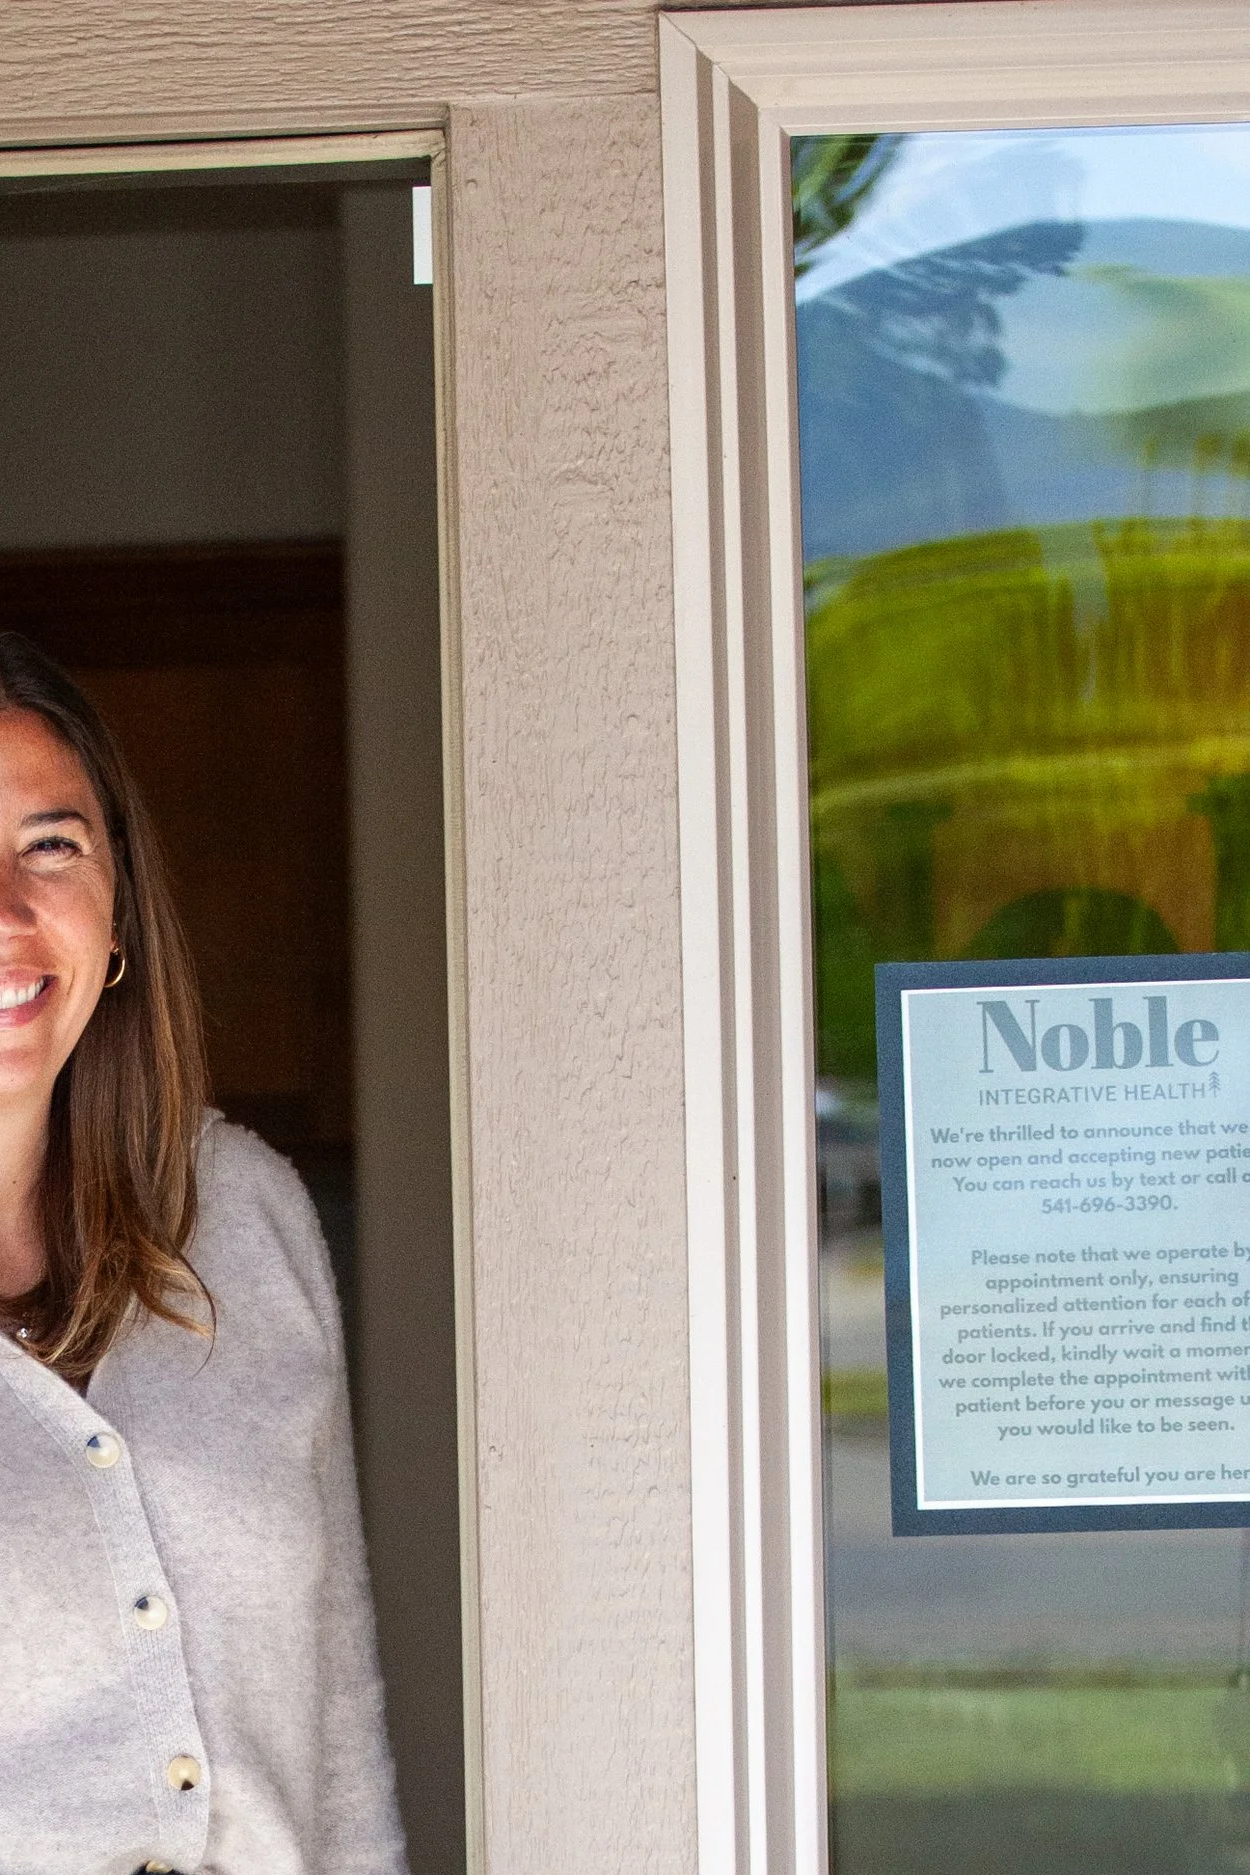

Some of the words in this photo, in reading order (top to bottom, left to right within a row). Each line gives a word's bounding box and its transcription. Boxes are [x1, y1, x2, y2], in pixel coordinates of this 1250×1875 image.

[976, 995, 1220, 1073] Noble
[979, 1085, 1117, 1106] INTEGRATIVE
[1124, 1082, 1206, 1101] HEALTH
[930, 1126, 984, 1144] We're
[989, 1124, 1056, 1142] thrilled
[1060, 1125, 1079, 1140] to
[1084, 1123, 1174, 1140] announce
[1178, 1120, 1216, 1135] that
[1220, 1123, 1248, 1134] we
[931, 1155, 972, 1169] now
[976, 1153, 1022, 1171] open
[1027, 1148, 1063, 1165] and
[1068, 1146, 1156, 1165] accepting
[1162, 1148, 1200, 1161] new
[953, 1176, 987, 1192] You
[993, 1179, 1025, 1191] can
[1030, 1173, 1081, 1190] reach
[1086, 1176, 1106, 1188] us
[1111, 1170, 1134, 1191] by
[1139, 1171, 1176, 1187] text
[1180, 1174, 1200, 1185] or
[1206, 1167, 1237, 1184] call
[1041, 1194, 1179, 1214] 541-696-3390.
[971, 1250, 1030, 1266] Please
[1035, 1249, 1075, 1264] note
[1081, 1246, 1119, 1262] that
[1123, 1249, 1151, 1261] we
[1155, 1244, 1229, 1263] operate
[986, 1273, 1104, 1294] appointment
[1109, 1270, 1153, 1289] only,
[1158, 1268, 1239, 1287] ensuring
[940, 1298, 1058, 1320] personalized
[1063, 1296, 1147, 1312] attention
[1152, 1293, 1179, 1309] for
[1183, 1292, 1227, 1308] each
[957, 1324, 1037, 1343] patients.
[1043, 1321, 1055, 1338] If
[1059, 1324, 1093, 1340] you
[1098, 1319, 1155, 1335] arrive
[1159, 1317, 1196, 1334] and
[1201, 1315, 1236, 1332] find
[1241, 1315, 1250, 1332] t
[942, 1348, 986, 1365] door
[991, 1347, 1055, 1365] locked,
[1061, 1345, 1118, 1364] kindly
[1123, 1344, 1165, 1360] wait
[1169, 1347, 1181, 1358] a
[938, 1376, 967, 1389] we
[971, 1371, 1055, 1391] complete
[1059, 1370, 1088, 1386] the
[1093, 1368, 1212, 1389] appointment
[955, 1398, 1021, 1417] patient
[1025, 1395, 1085, 1412] before
[1090, 1398, 1125, 1414] you
[1129, 1397, 1151, 1409] or
[1155, 1394, 1235, 1411] message
[998, 1423, 1032, 1441] you
[1037, 1419, 1095, 1436] would
[1099, 1417, 1132, 1434] like
[1137, 1418, 1155, 1433] to
[1161, 1416, 1183, 1432] be
[1188, 1419, 1235, 1432] seen.
[970, 1470, 1000, 1486] We
[1005, 1473, 1037, 1485] are
[1041, 1472, 1062, 1484] so
[1067, 1467, 1140, 1488] grateful
[1145, 1470, 1179, 1486] you
[1184, 1469, 1216, 1481] are
